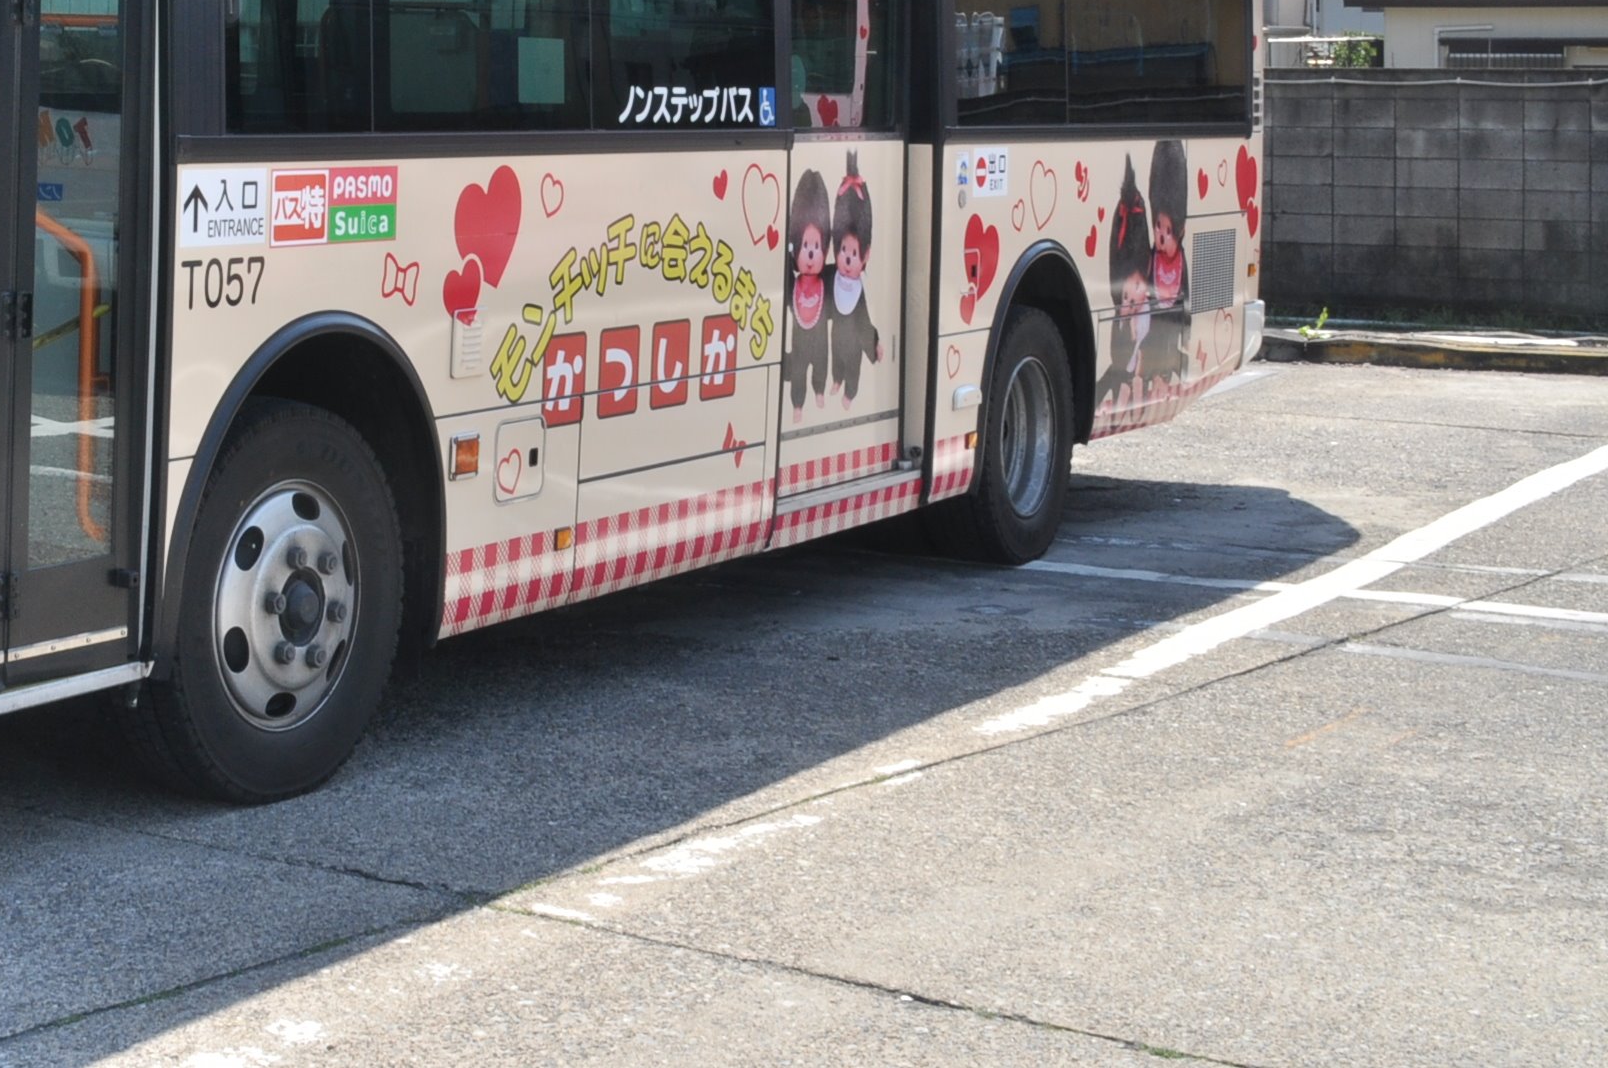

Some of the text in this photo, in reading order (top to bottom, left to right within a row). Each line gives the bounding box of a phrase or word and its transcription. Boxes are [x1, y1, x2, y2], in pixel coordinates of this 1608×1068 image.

[618, 85, 754, 124] ノンステップバス
[988, 153, 1006, 174] 出口
[215, 179, 258, 212] 入口
[333, 174, 393, 200] PASMO
[274, 184, 325, 230] バス特
[334, 211, 389, 236] Suica
[207, 217, 264, 238] ENTRANCE
[181, 256, 265, 310] T057
[490, 213, 775, 404] モンチッチに会えるまち
[544, 327, 736, 412] かつしか
